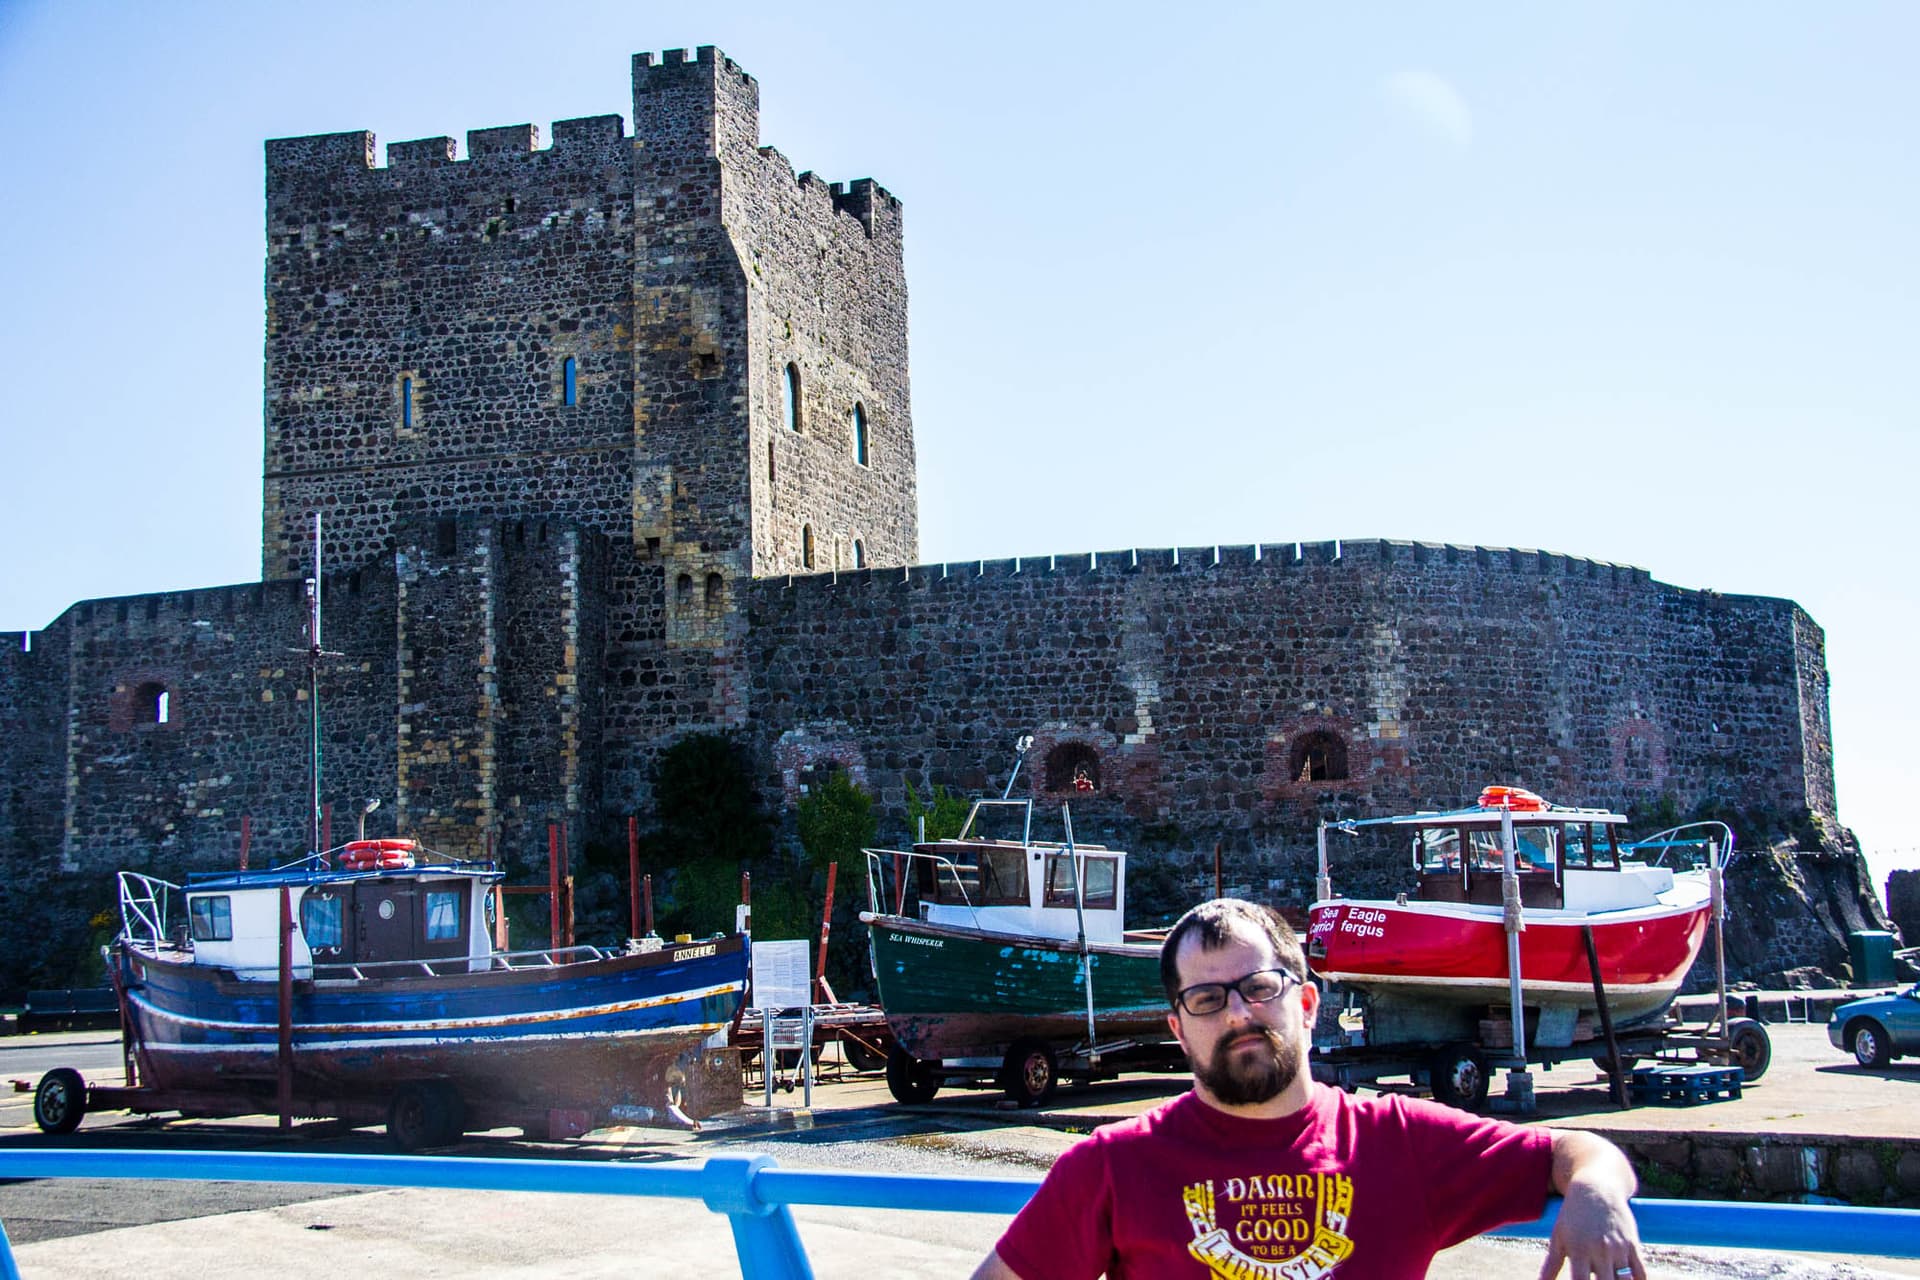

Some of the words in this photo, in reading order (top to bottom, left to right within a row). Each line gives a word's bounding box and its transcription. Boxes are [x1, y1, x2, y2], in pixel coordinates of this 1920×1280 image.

[1321, 907, 1339, 919] Sea
[1348, 908, 1386, 923] Eagle
[1340, 919, 1384, 937] fergus
[889, 933, 902, 942] SEA
[905, 935, 944, 947] WHISPERER
[1227, 1174, 1315, 1201] DAMN
[1241, 1204, 1258, 1217] IT
[1261, 1203, 1303, 1216] FEELS
[1235, 1218, 1309, 1242] GOOD
[1204, 1237, 1341, 1280] LANNISTER
[1251, 1245, 1268, 1256] TO
[1271, 1245, 1286, 1256] BE
[1288, 1244, 1297, 1255] A
